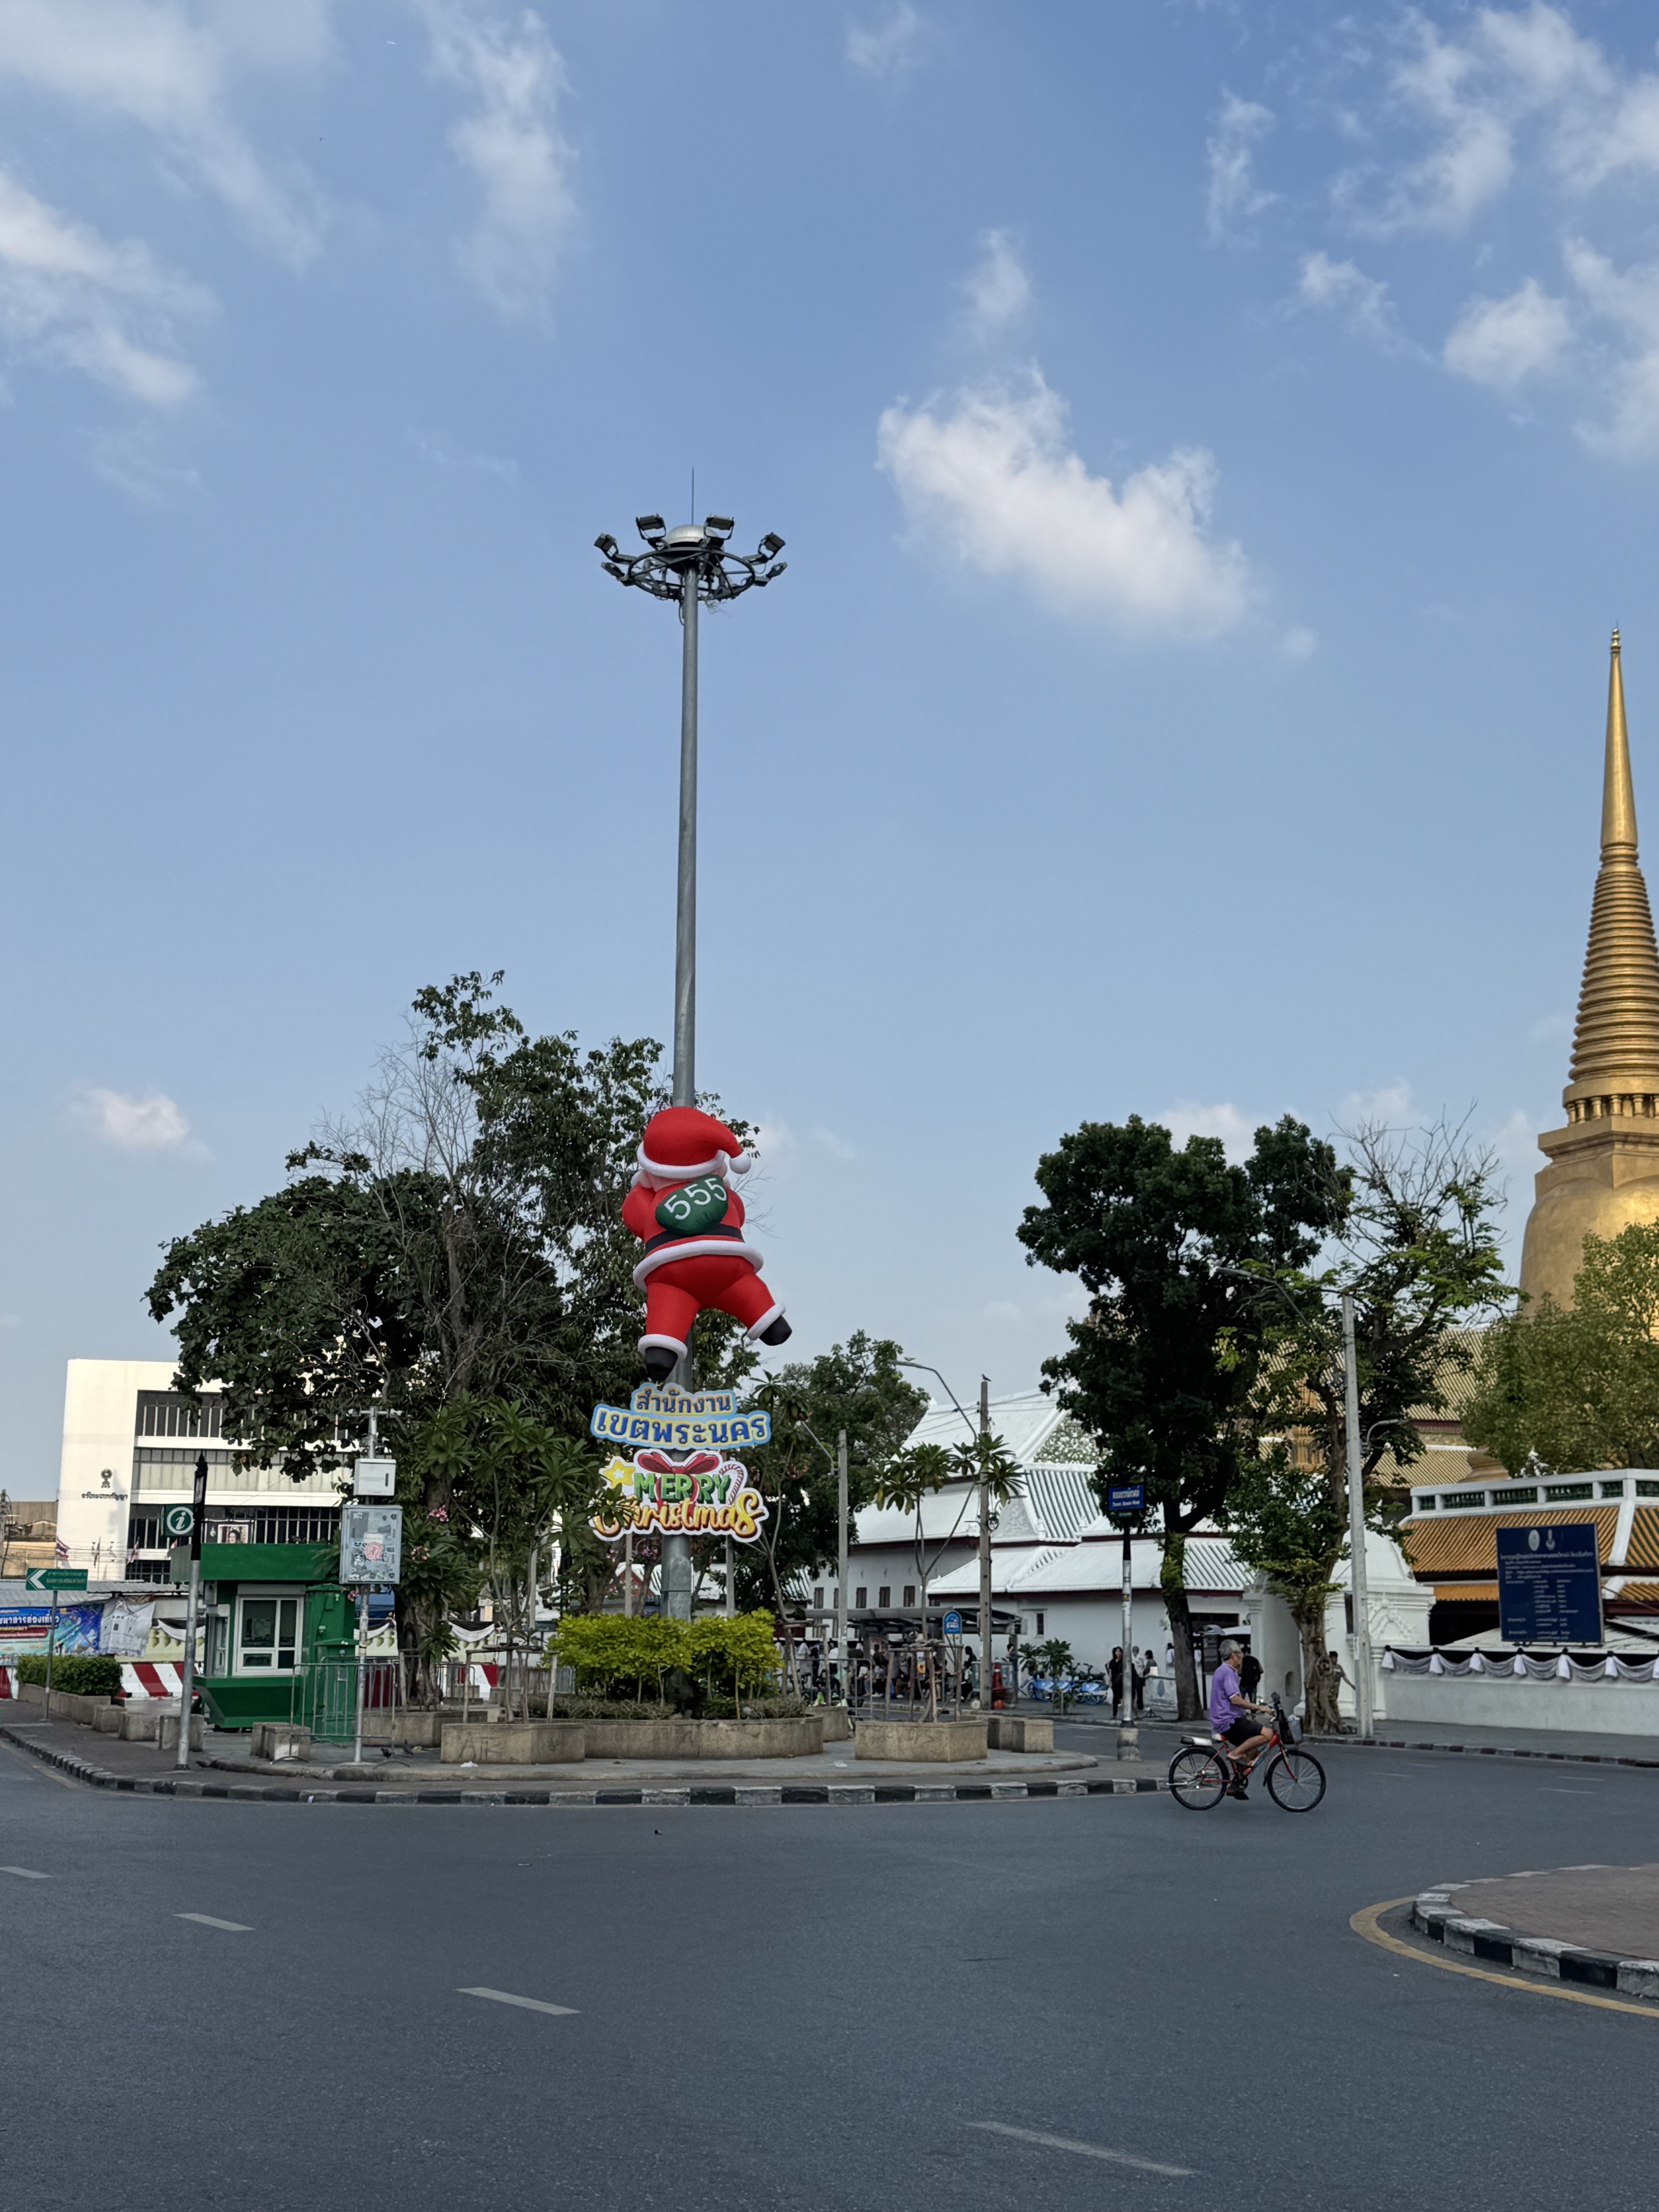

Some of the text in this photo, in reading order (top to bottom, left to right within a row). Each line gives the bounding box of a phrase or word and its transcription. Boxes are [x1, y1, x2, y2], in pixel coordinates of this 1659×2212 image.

[664, 1177, 727, 1220] 555
[636, 1388, 731, 1414] สำนักงาน
[597, 1411, 765, 1444] เขตพระนคร
[634, 1473, 731, 1504] MERRY
